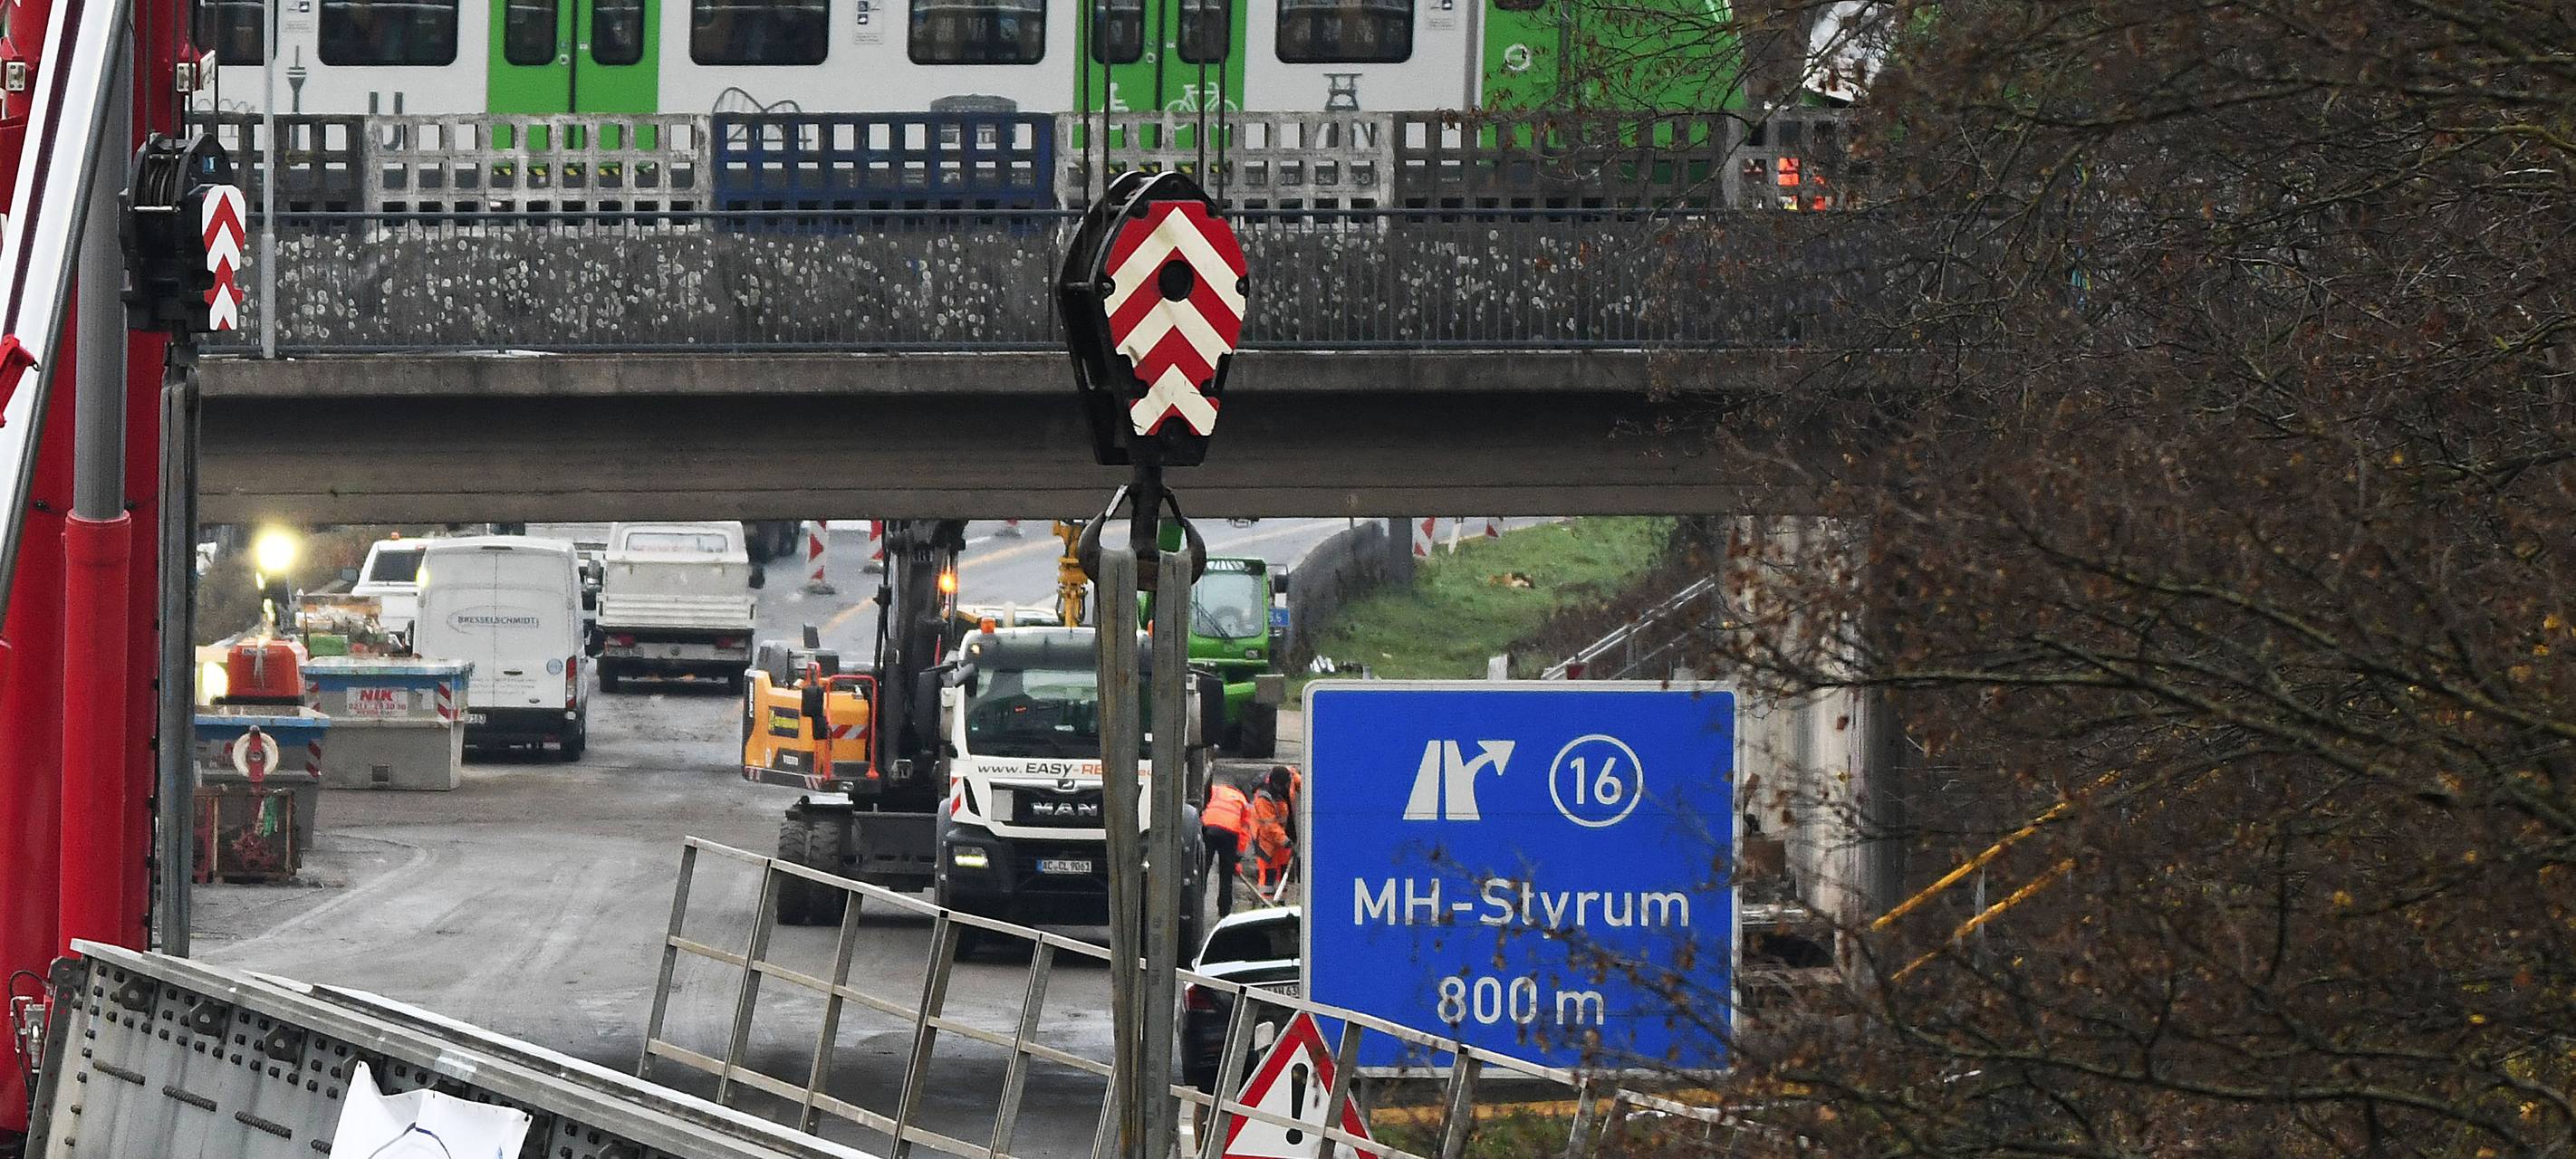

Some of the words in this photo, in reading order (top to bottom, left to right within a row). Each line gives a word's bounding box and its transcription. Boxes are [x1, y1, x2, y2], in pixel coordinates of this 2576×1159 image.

[360, 689, 393, 702] NIK
[978, 762, 1103, 778] www.EASY-RE
[1568, 757, 1623, 806] 16
[1033, 802, 1098, 816] MAN
[1353, 877, 1690, 939] MH-Styrum
[1437, 975, 1539, 1027] 800
[1555, 988, 1604, 1026] m
